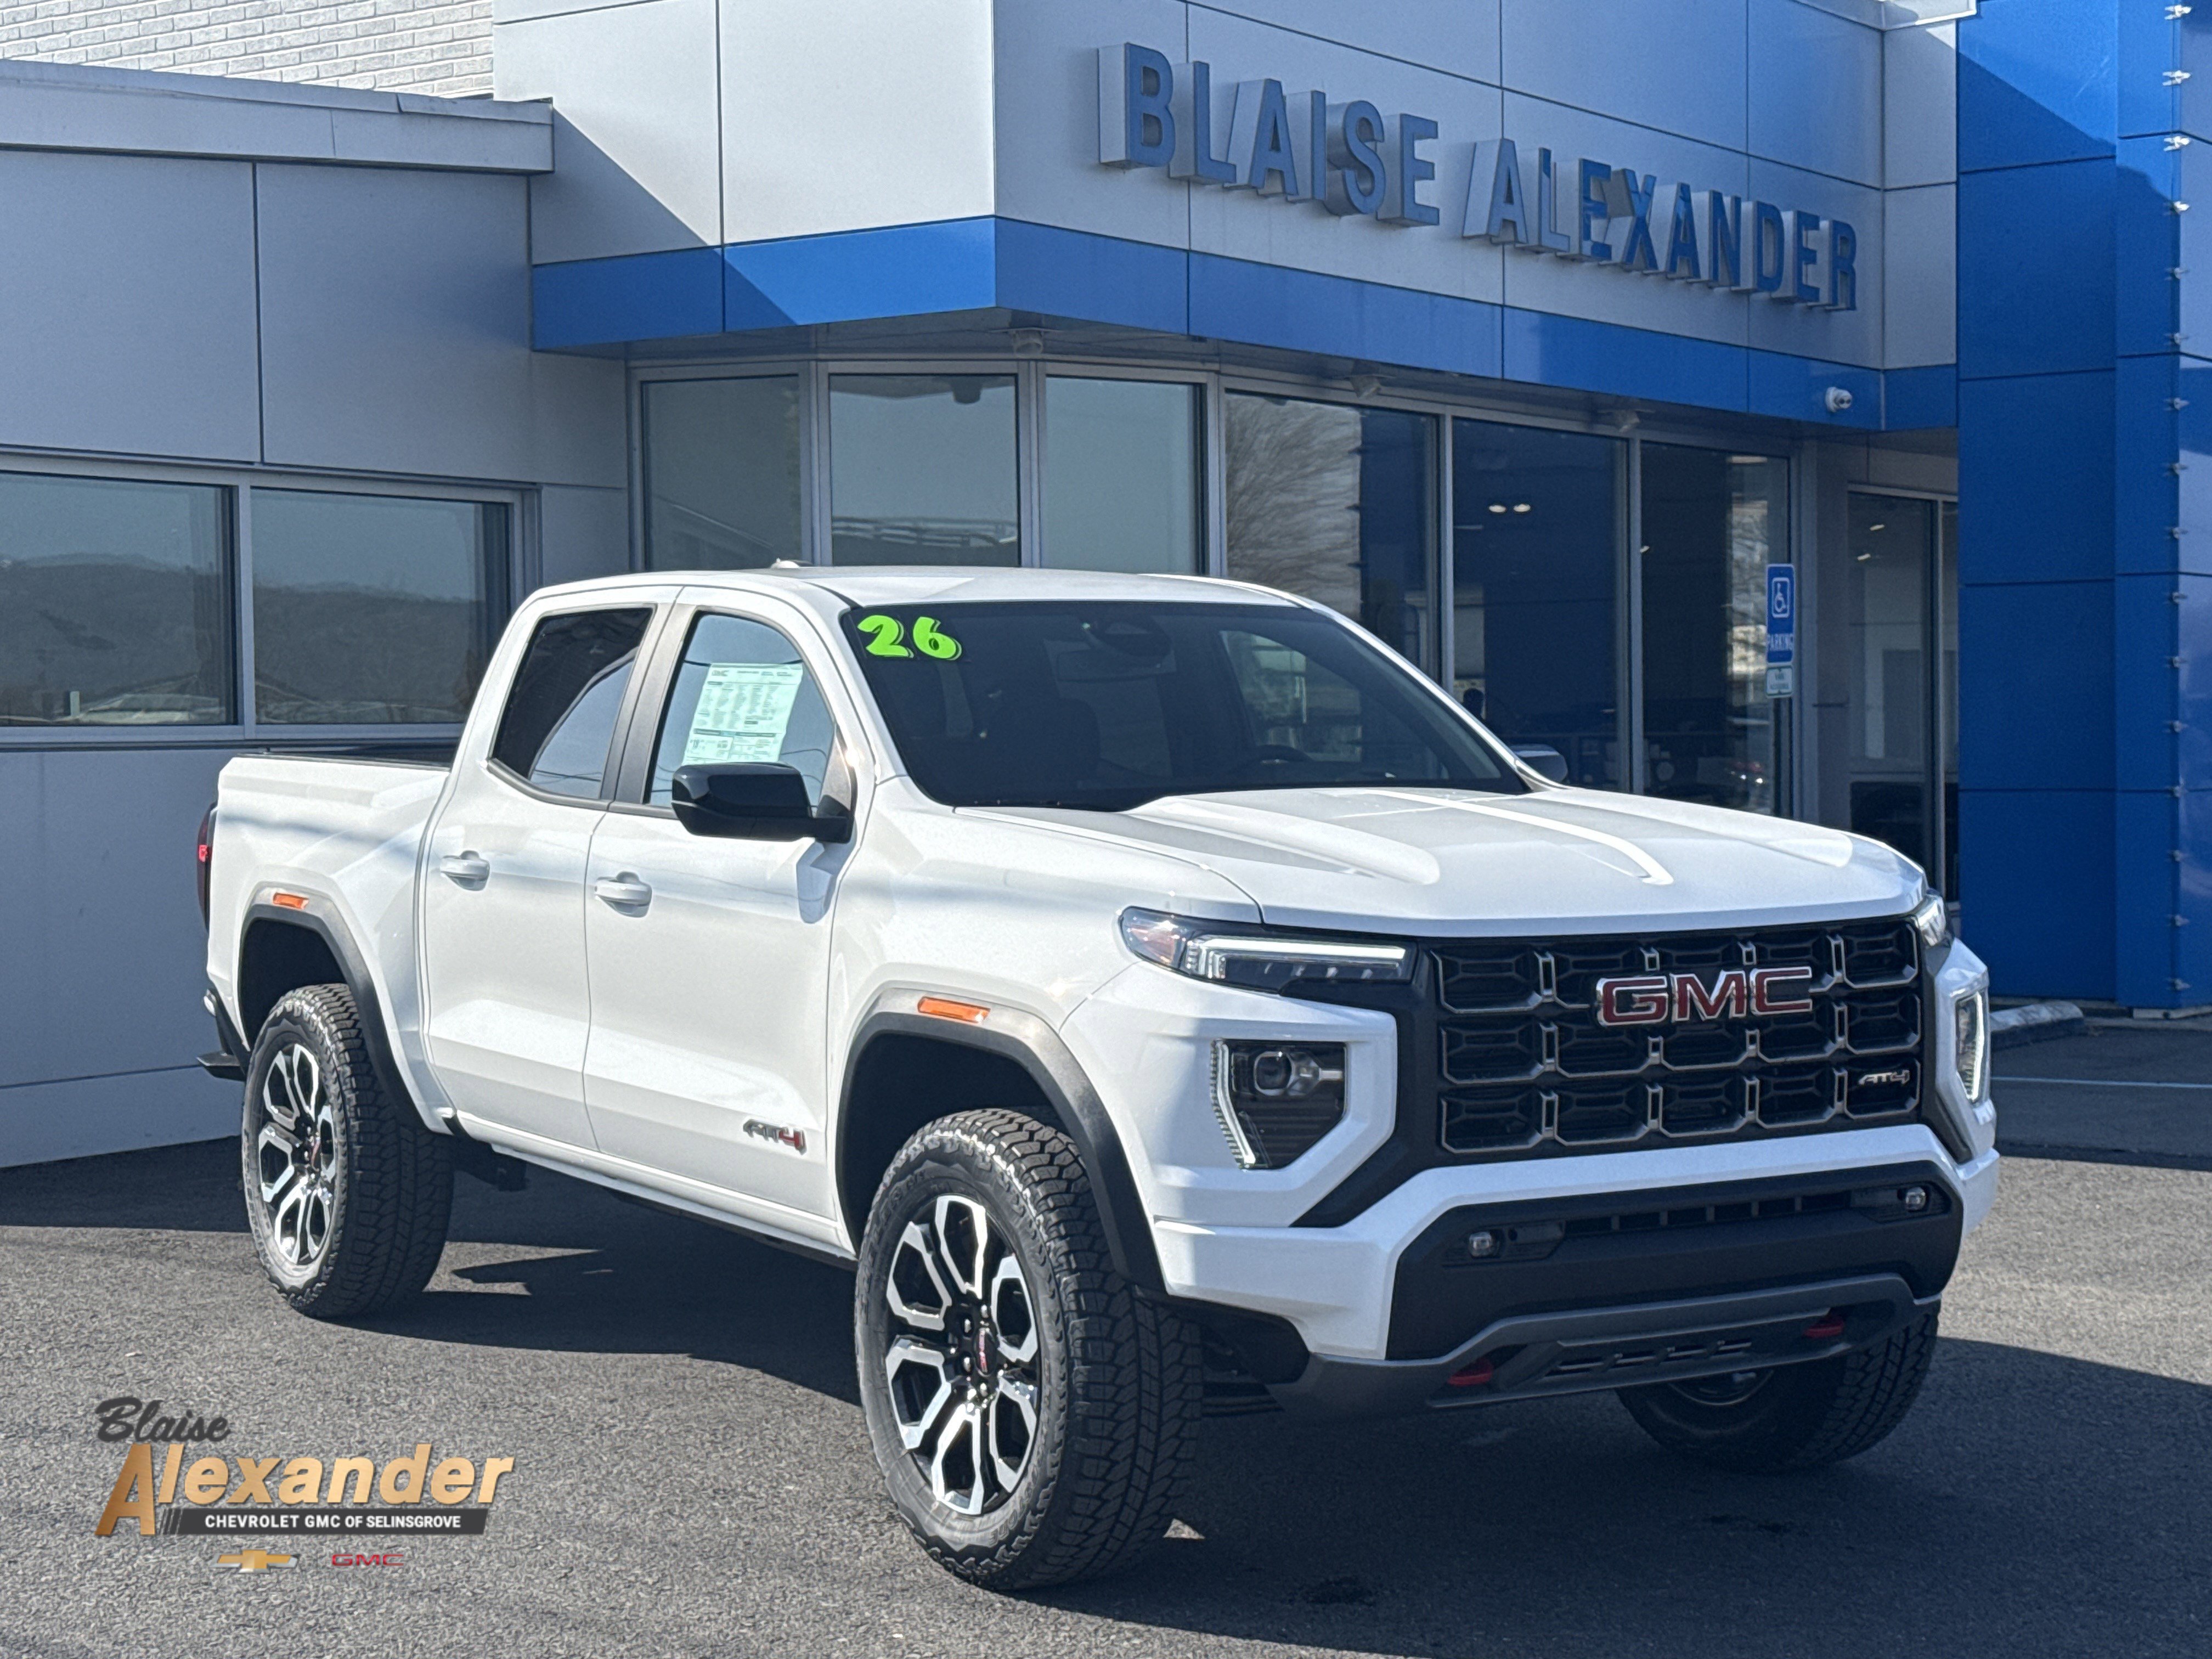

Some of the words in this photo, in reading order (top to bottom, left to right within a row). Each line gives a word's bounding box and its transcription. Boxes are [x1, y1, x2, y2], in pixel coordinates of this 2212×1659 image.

[1124, 42, 1440, 226] BLAISE
[1487, 138, 1857, 311] ALEXANDER
[857, 614, 962, 661] 26
[1767, 633, 1793, 651] PARKING
[1596, 966, 1812, 1026] GMC
[1858, 1069, 1910, 1085] AT4
